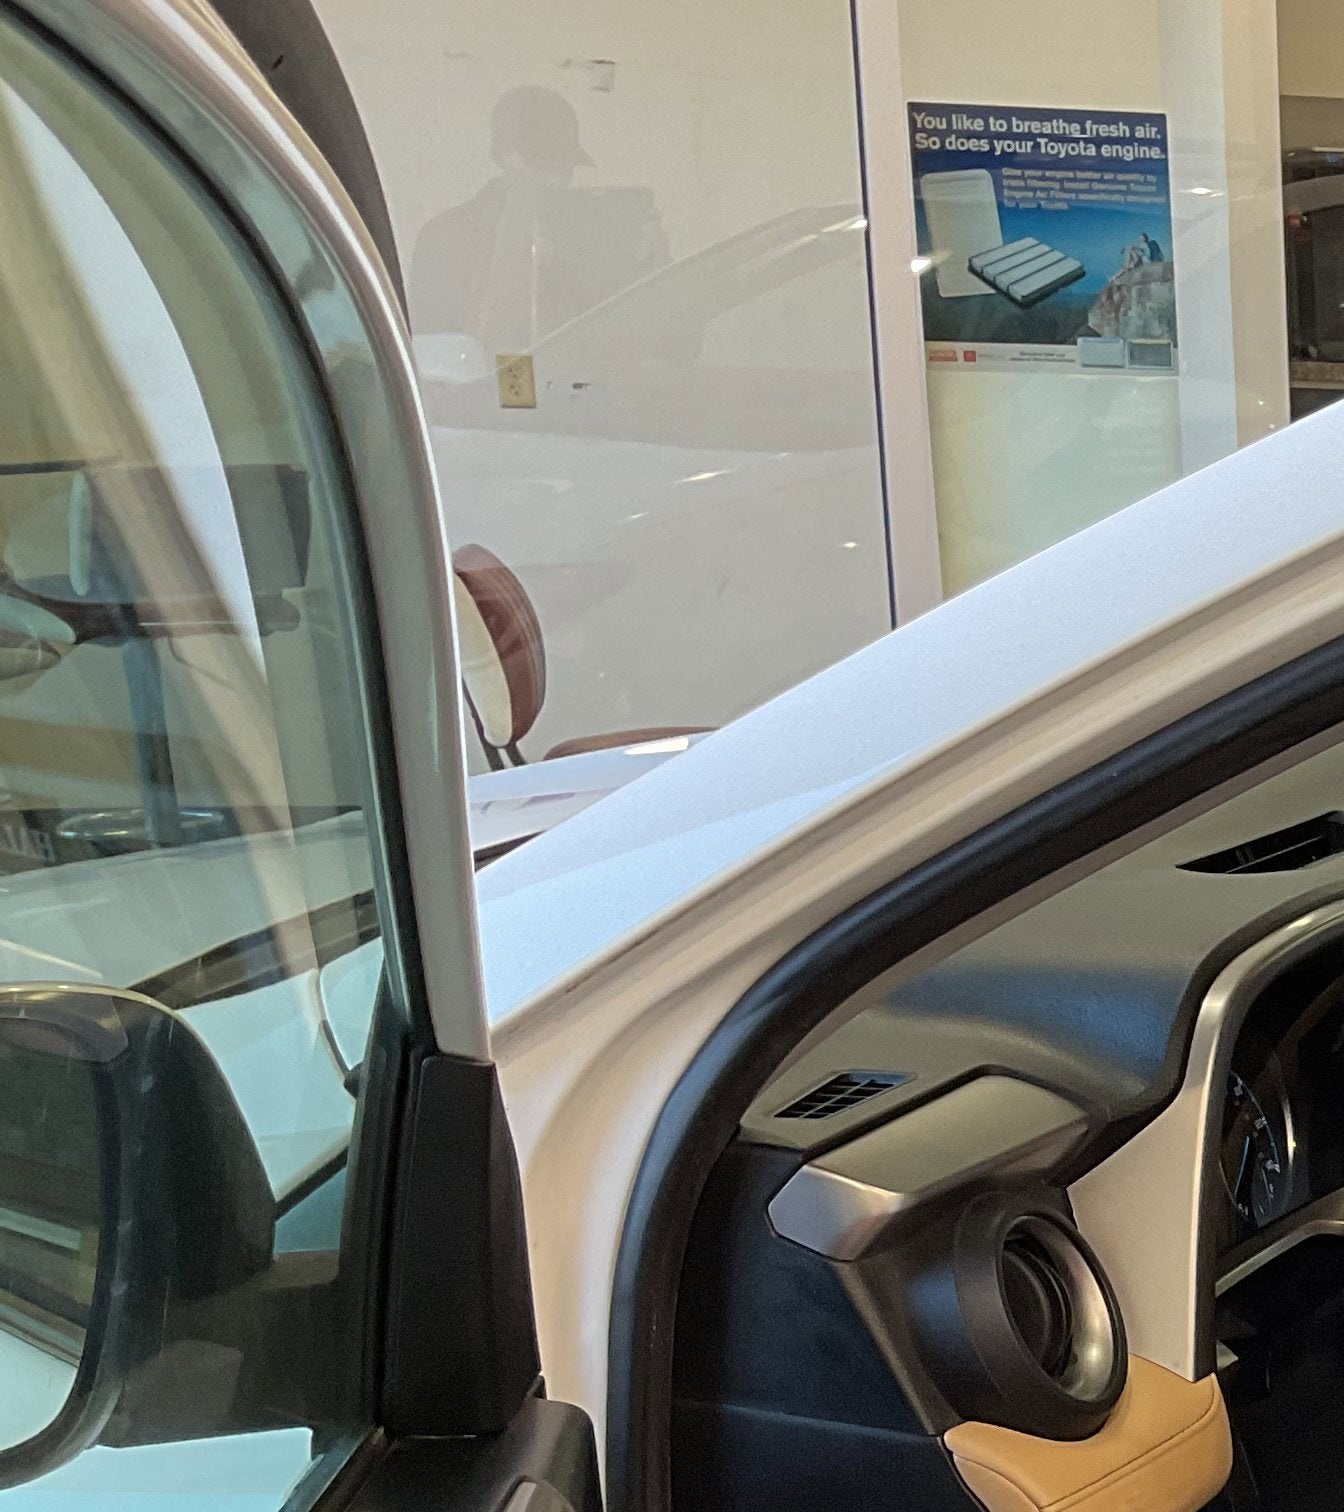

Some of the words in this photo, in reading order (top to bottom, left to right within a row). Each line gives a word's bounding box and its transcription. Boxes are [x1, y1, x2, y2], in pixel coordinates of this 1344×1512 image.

[912, 112, 947, 130] You
[952, 114, 985, 131] like
[989, 116, 1008, 132] to
[1012, 116, 1081, 135] breathe
[1085, 120, 1130, 138] fresh
[1135, 122, 1161, 139] air.
[915, 132, 941, 150] So
[945, 134, 990, 151] does
[994, 139, 1034, 156] your
[1037, 138, 1097, 158] Toyota
[1101, 142, 1166, 161] engine.
